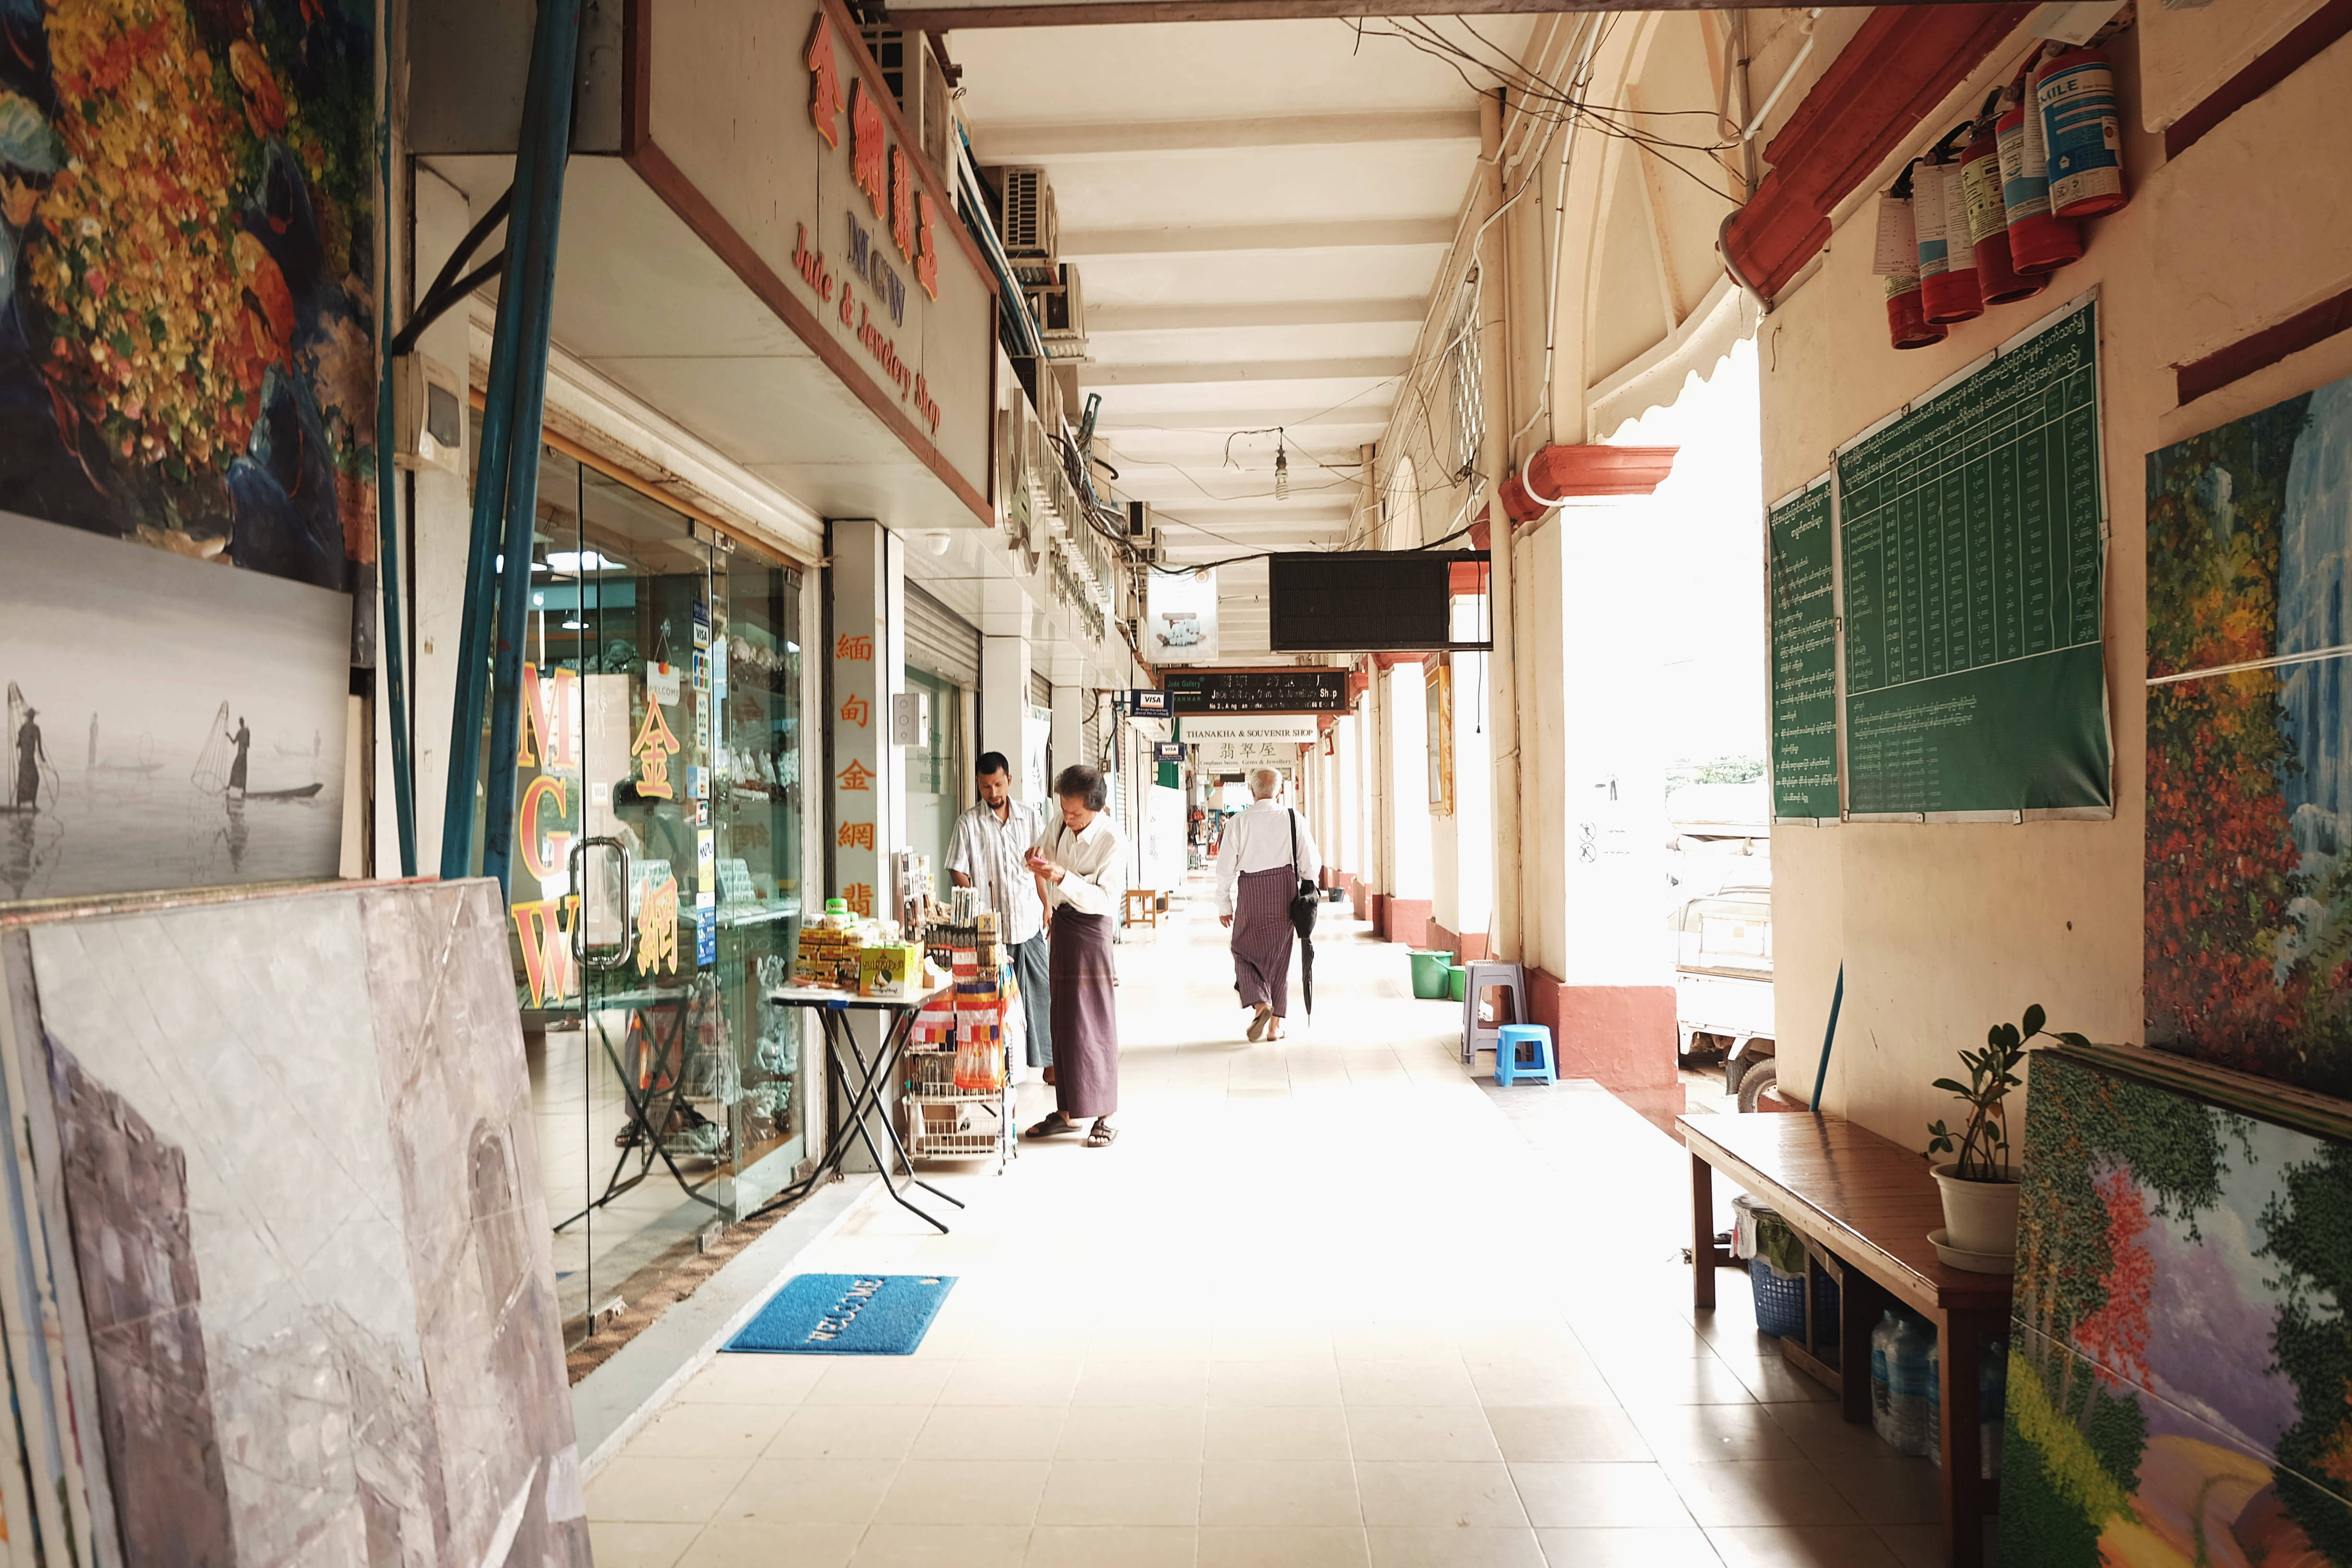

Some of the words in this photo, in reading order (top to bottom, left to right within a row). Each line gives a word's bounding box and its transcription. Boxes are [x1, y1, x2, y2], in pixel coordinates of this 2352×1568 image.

[847, 211, 906, 327] MGW
[794, 222, 833, 303] Jade
[840, 282, 853, 329] &
[858, 303, 911, 402] Jewelery
[915, 373, 941, 436] Shop
[696, 628, 707, 642] VISA
[1320, 688, 1337, 700] Shp
[1186, 730, 1236, 738] THANAKHA
[1247, 729, 1291, 737] SOUVENIR
[1220, 743, 1276, 759] 翡翠屋
[594, 787, 606, 797] VISA
[511, 662, 579, 1009] MGW
[631, 691, 680, 978] 金網
[805, 1277, 886, 1343] WELCOME
